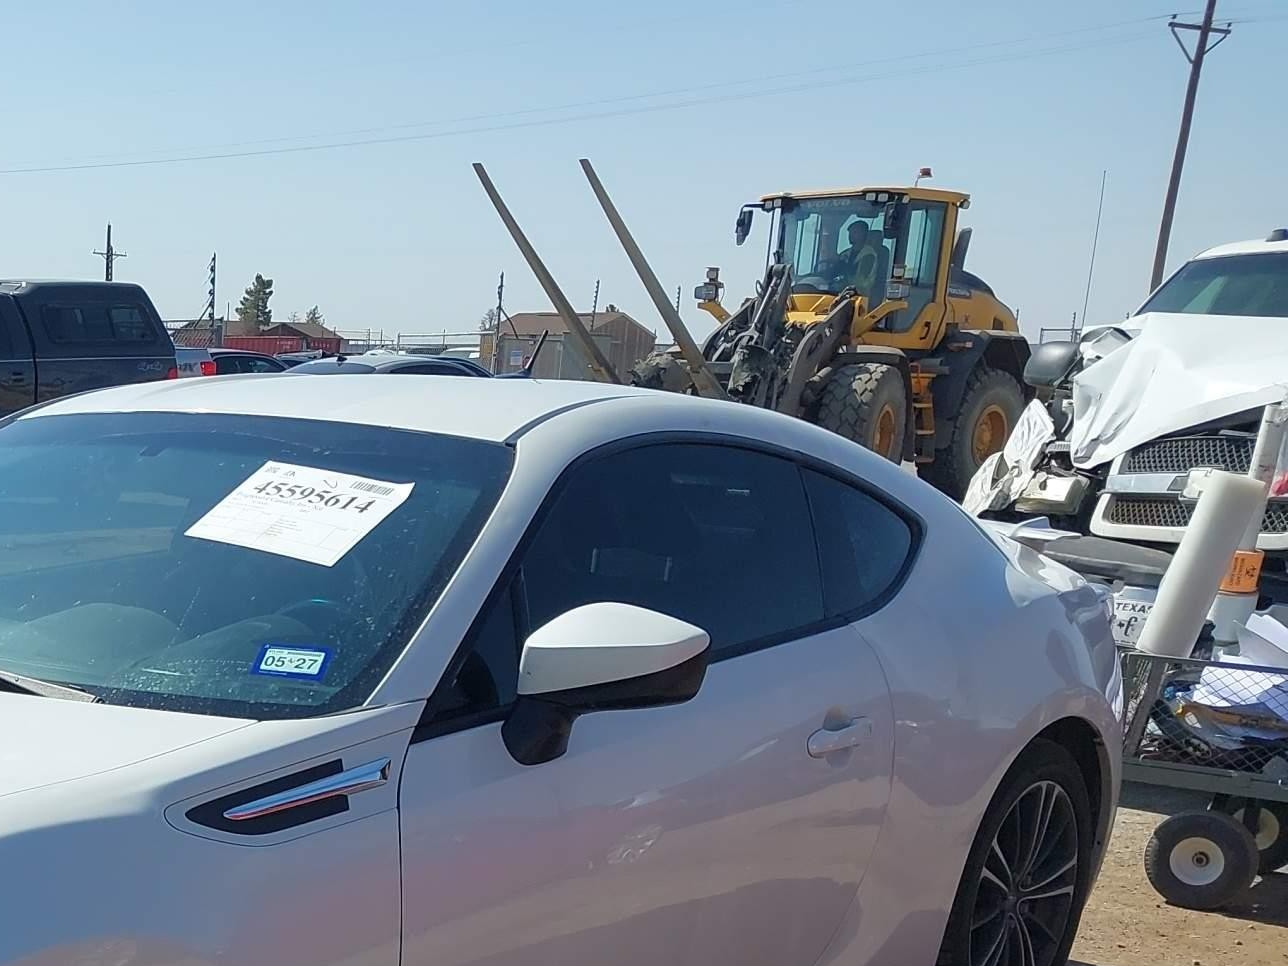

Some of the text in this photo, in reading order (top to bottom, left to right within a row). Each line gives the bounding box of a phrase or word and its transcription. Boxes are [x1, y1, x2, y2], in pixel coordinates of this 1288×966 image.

[253, 480, 377, 513] 45595614
[264, 655, 319, 670] 05 27
